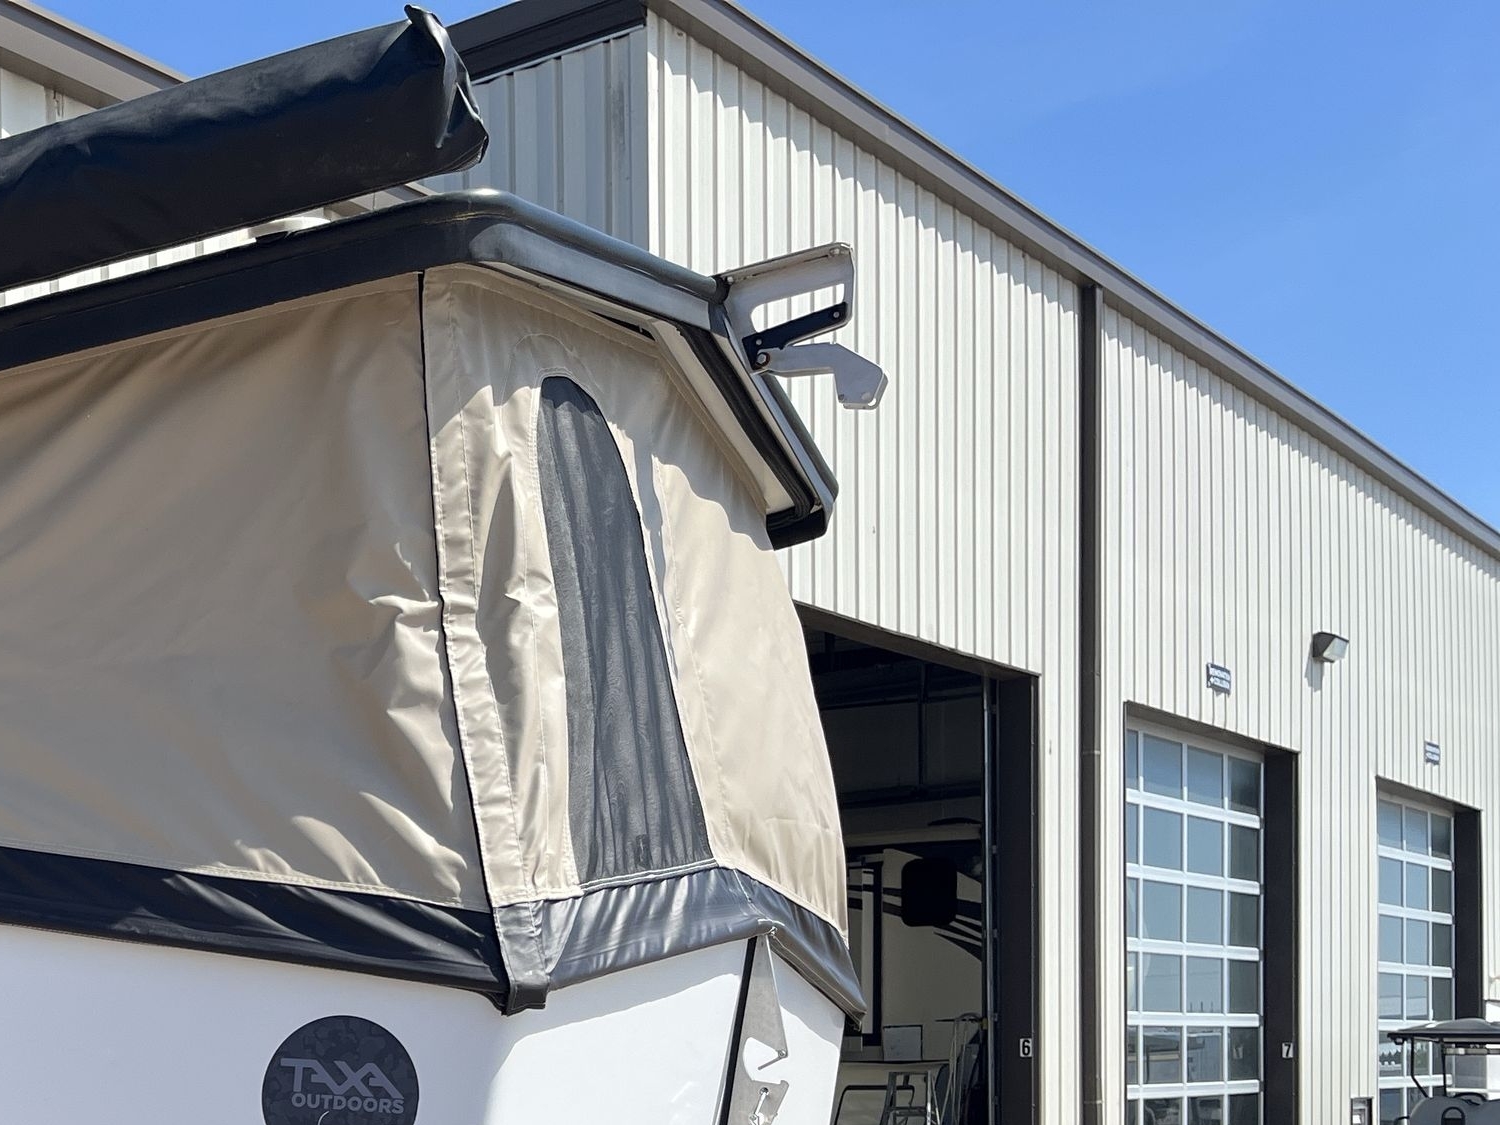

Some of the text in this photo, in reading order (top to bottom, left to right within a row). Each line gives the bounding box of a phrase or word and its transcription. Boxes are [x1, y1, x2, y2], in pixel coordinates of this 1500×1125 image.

[1022, 1039, 1031, 1056] 6
[280, 1057, 404, 1100] TAXA
[291, 1092, 404, 1115] OUTDOORS
